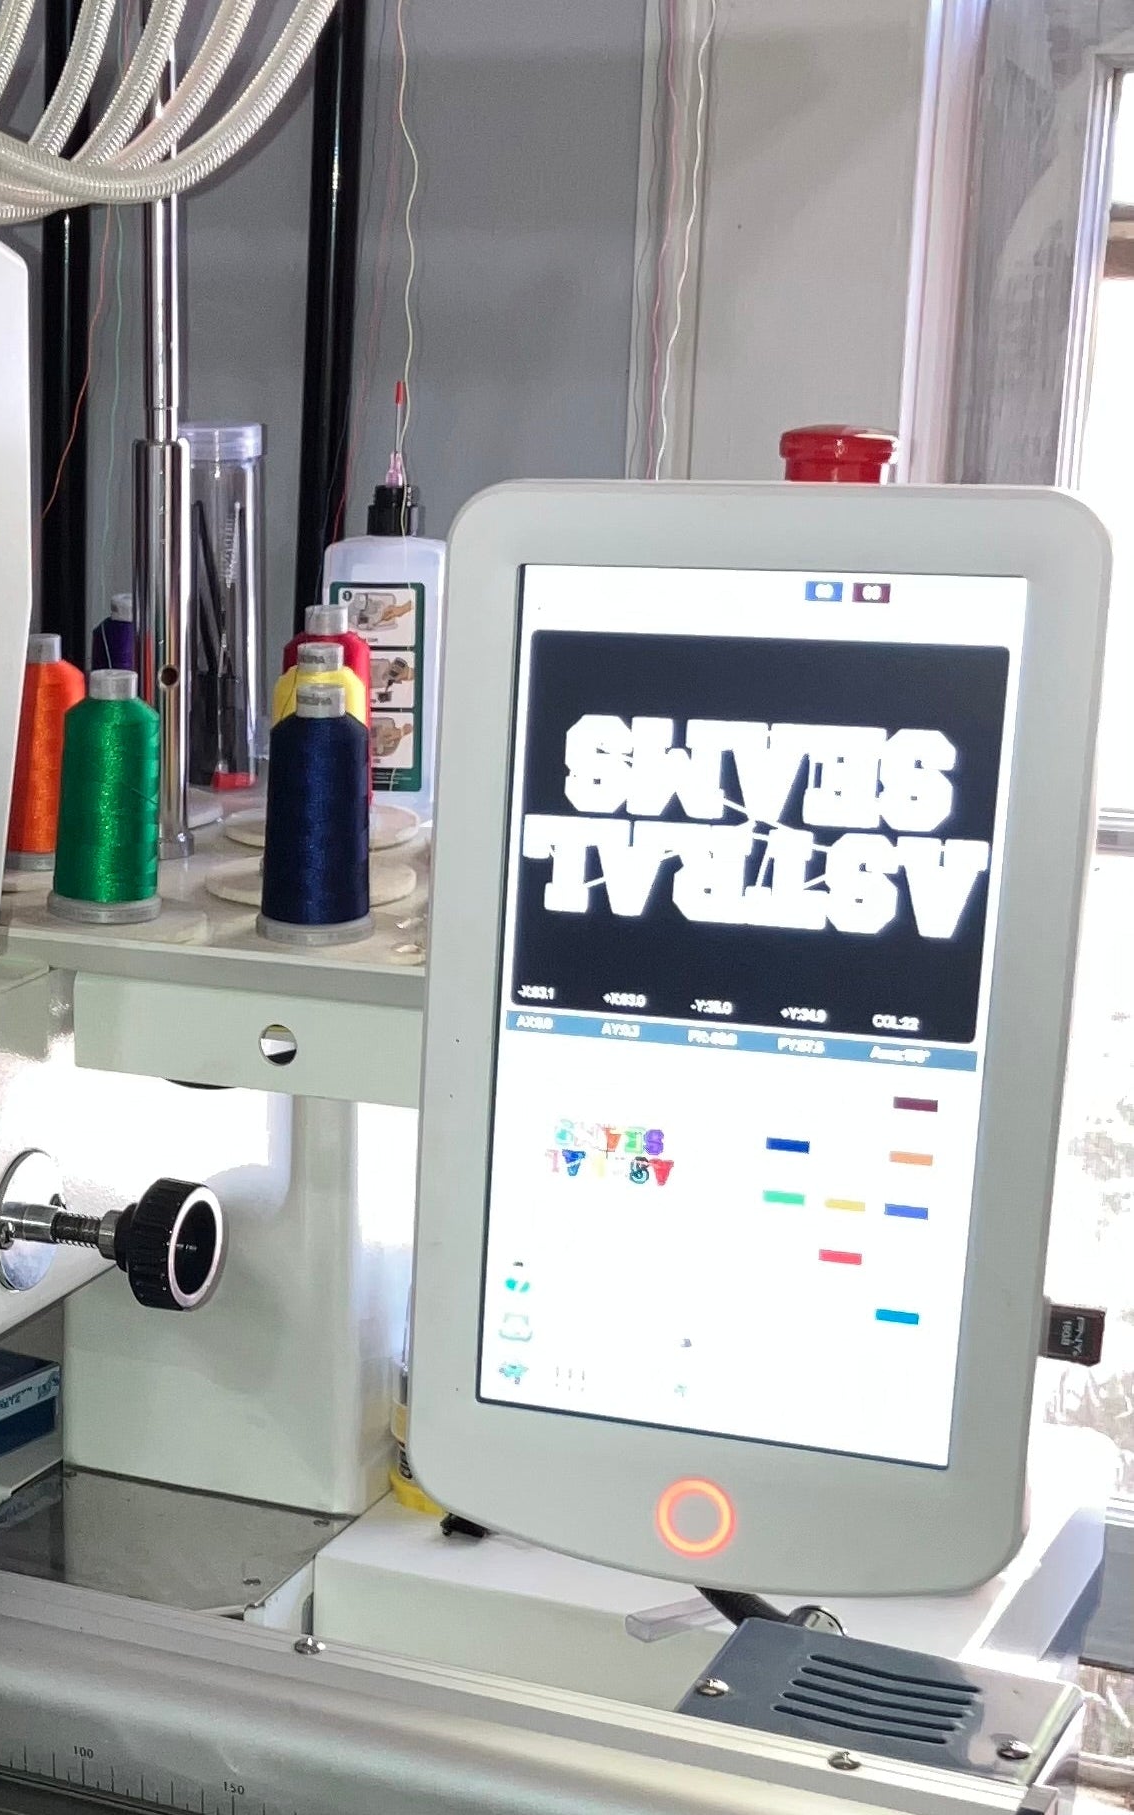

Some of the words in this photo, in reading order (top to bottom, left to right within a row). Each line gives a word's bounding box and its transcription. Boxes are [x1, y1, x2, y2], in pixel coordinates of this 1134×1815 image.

[565, 714, 957, 831] SEAMS
[523, 814, 989, 939] ASTRAL
[73, 1745, 94, 1759] 100
[223, 1781, 245, 1795] 150
